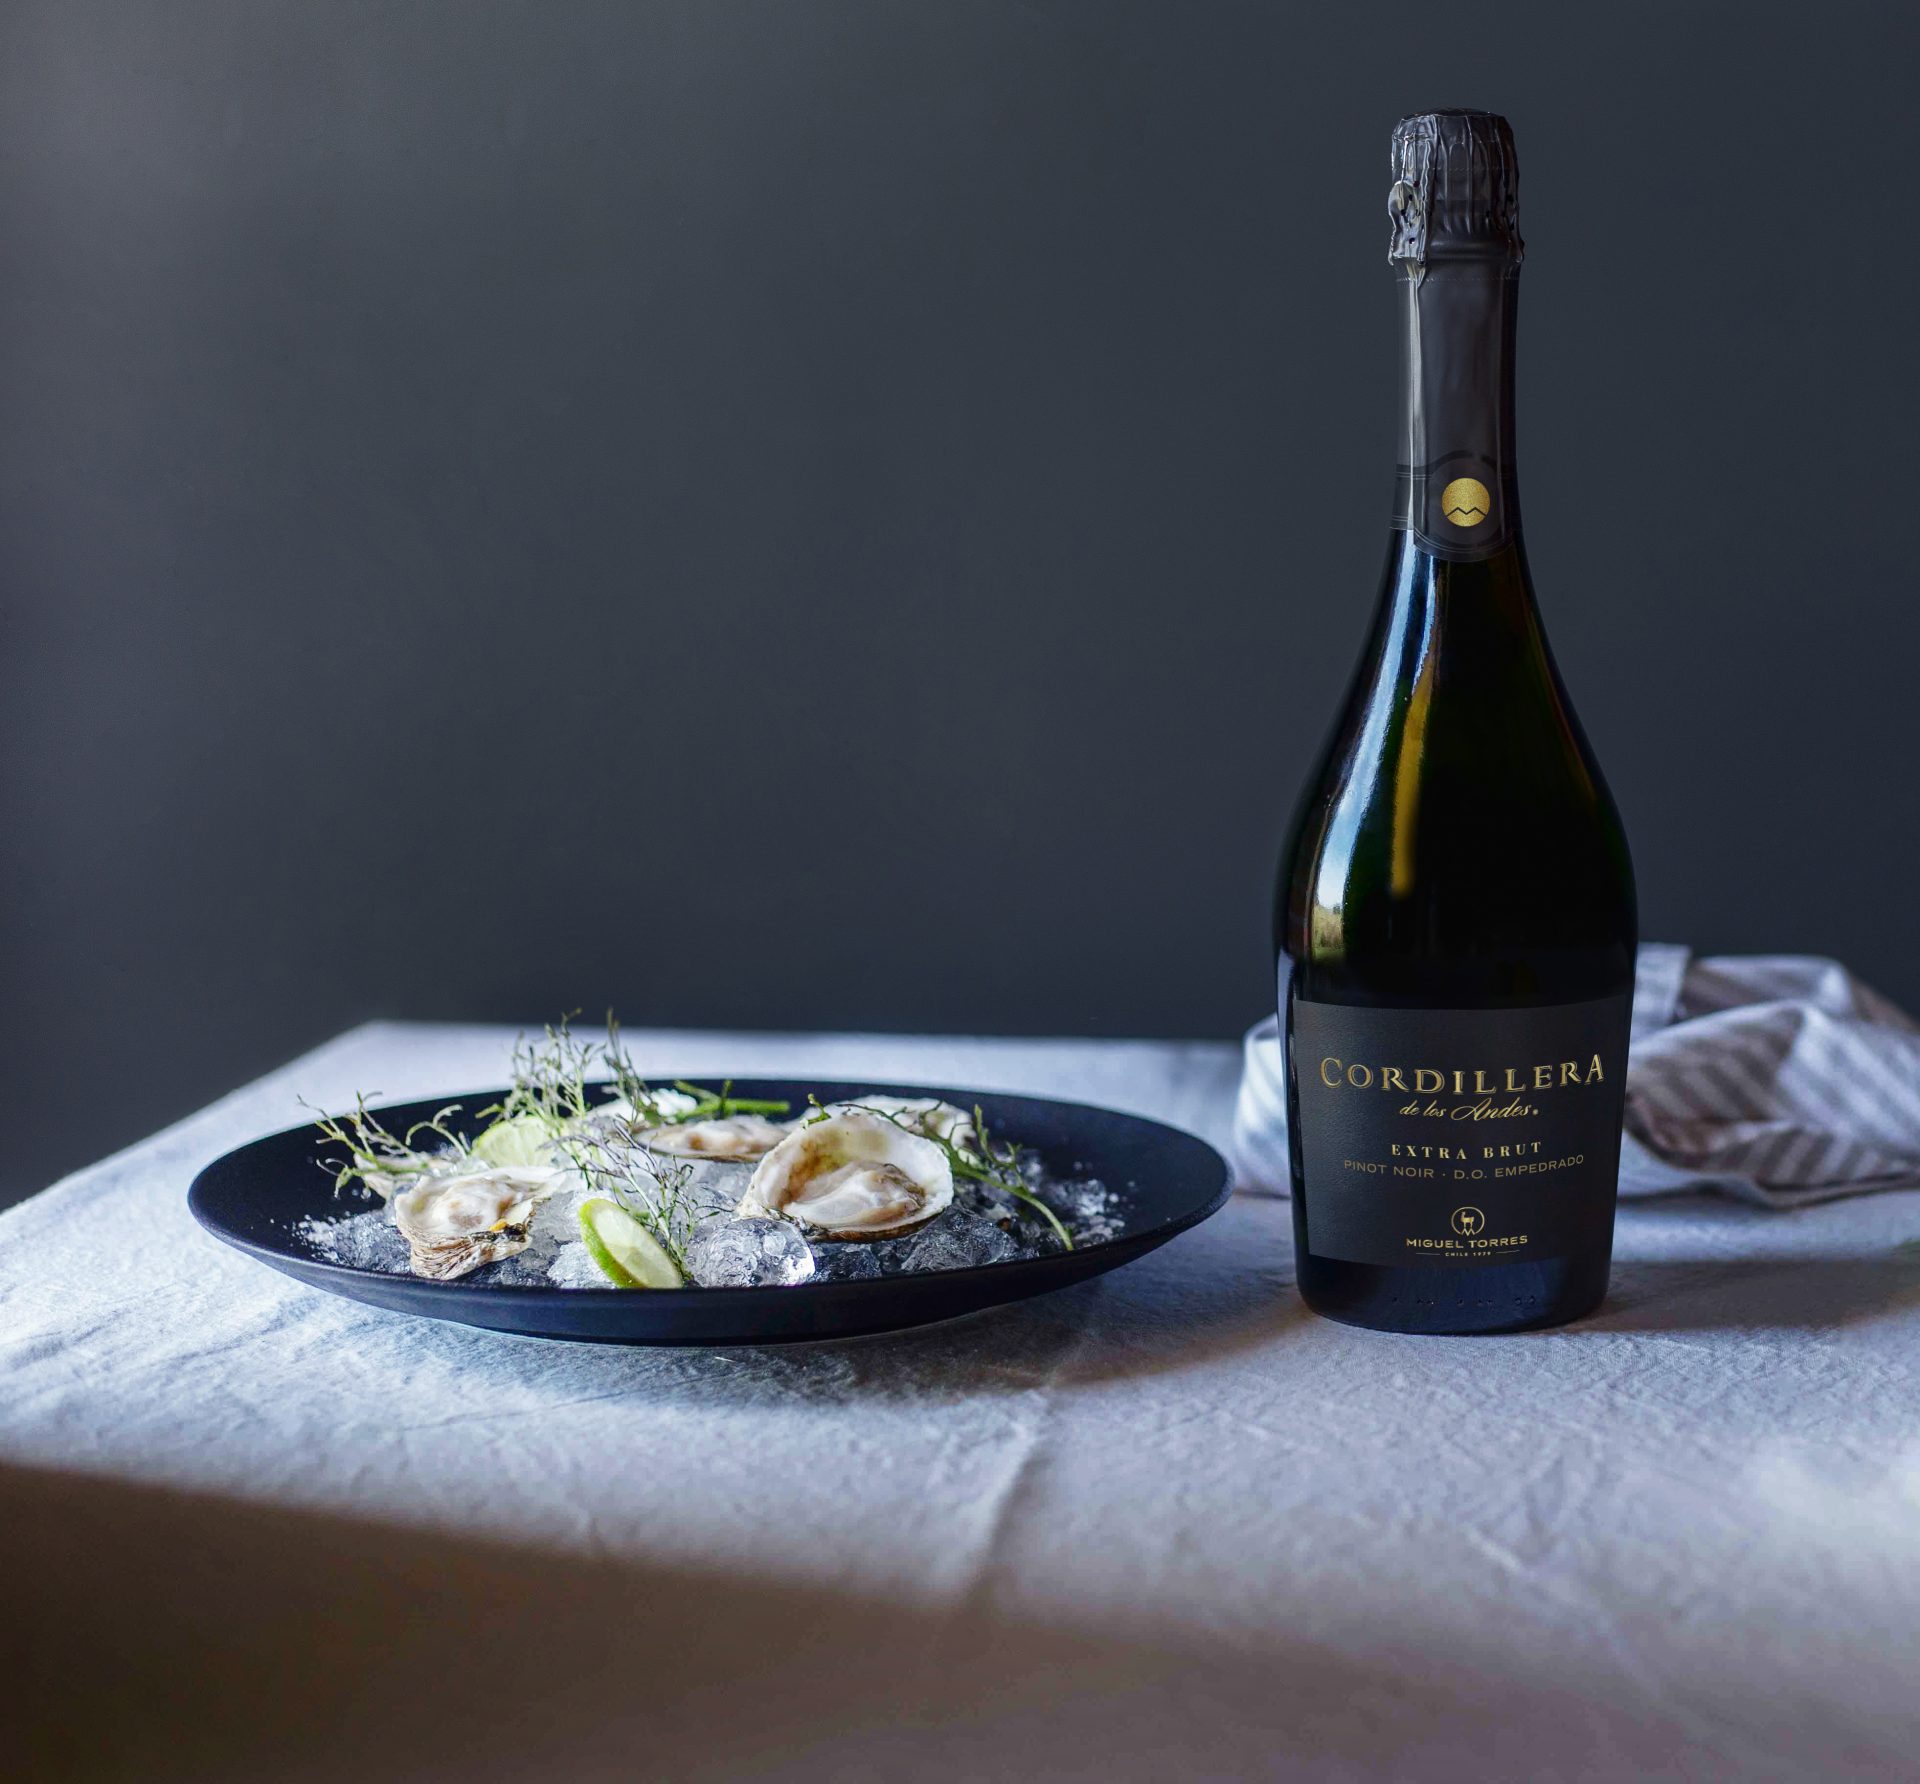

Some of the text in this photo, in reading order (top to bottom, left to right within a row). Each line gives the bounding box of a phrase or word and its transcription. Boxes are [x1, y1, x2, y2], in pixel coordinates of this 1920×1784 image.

[1320, 1054, 1605, 1095] CORDILLERA
[1400, 1100, 1420, 1116] de
[1423, 1100, 1447, 1117] los
[1391, 1142, 1542, 1160] EXTRA BRUT
[1344, 1154, 1585, 1179] PINOT NOIR D.O. EMPEDRADO
[1406, 1235, 1528, 1249] MIGUEL TORRES
